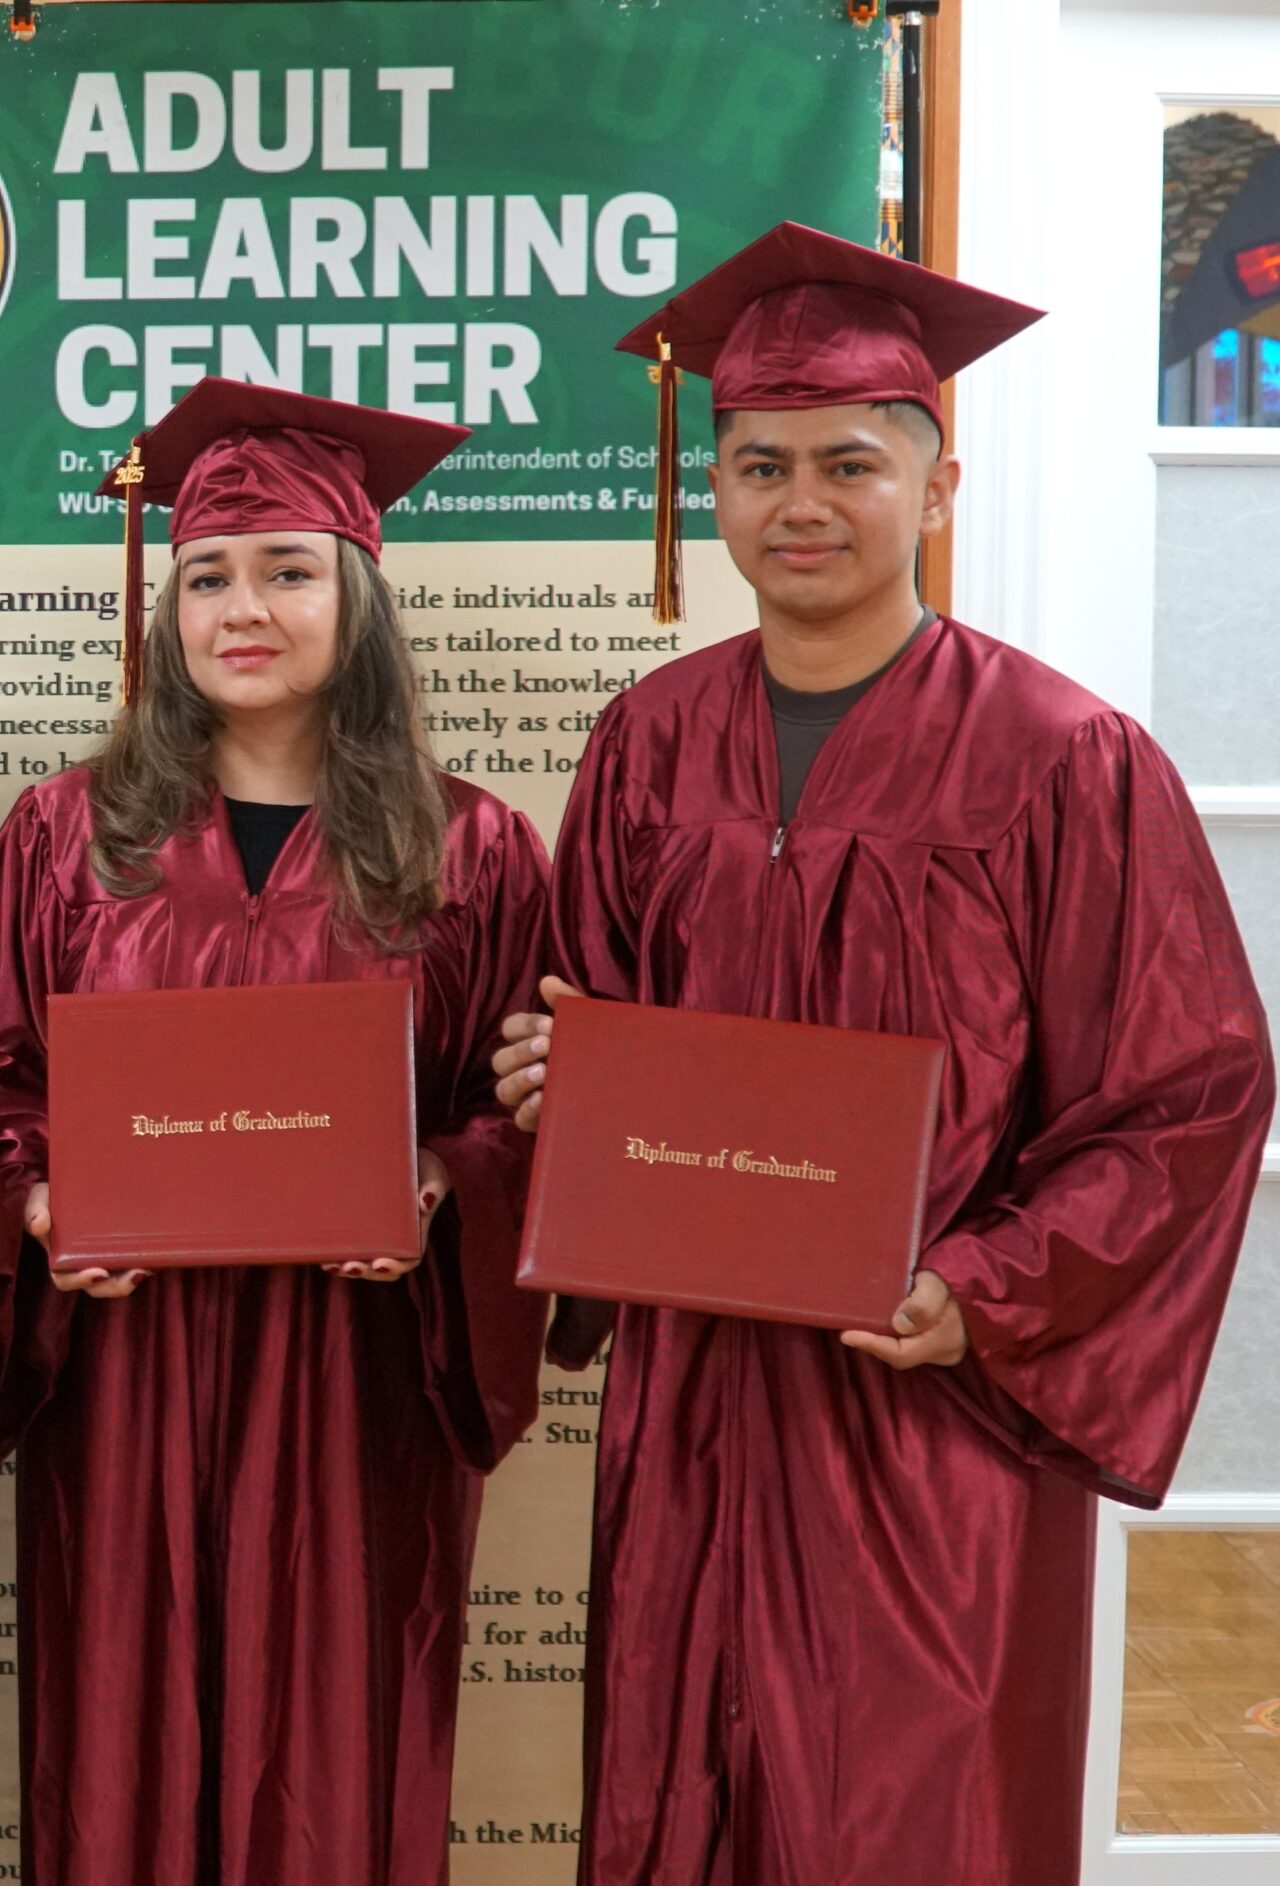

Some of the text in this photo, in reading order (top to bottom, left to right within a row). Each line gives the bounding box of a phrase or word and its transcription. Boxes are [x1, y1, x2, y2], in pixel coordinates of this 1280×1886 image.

[54, 67, 453, 174] ADULT
[57, 191, 678, 300] LEARNING
[55, 322, 541, 430] CENTER
[60, 450, 94, 473] Dr.
[434, 448, 581, 472] erintendent
[587, 446, 613, 469] of
[114, 465, 146, 486] 2025
[58, 491, 151, 515] WUF
[423, 489, 592, 512] Assessments
[597, 487, 617, 511] &
[394, 585, 444, 609] ide
[452, 584, 617, 609] individuals
[446, 628, 563, 652] tailored
[569, 632, 600, 652] to
[607, 631, 682, 652] meet
[457, 669, 507, 693] the
[422, 708, 508, 738] tively
[518, 716, 548, 733] as
[19, 756, 49, 776] to
[446, 749, 479, 773] of
[485, 749, 534, 773] the
[131, 1109, 332, 1138] Diploma of Graduation
[624, 1136, 839, 1184] Diploma of Graduation
[541, 1386, 602, 1406] stru
[545, 1422, 597, 1444] Stu
[534, 1587, 564, 1606] to
[483, 1621, 527, 1645] for
[476, 1821, 524, 1844] the
